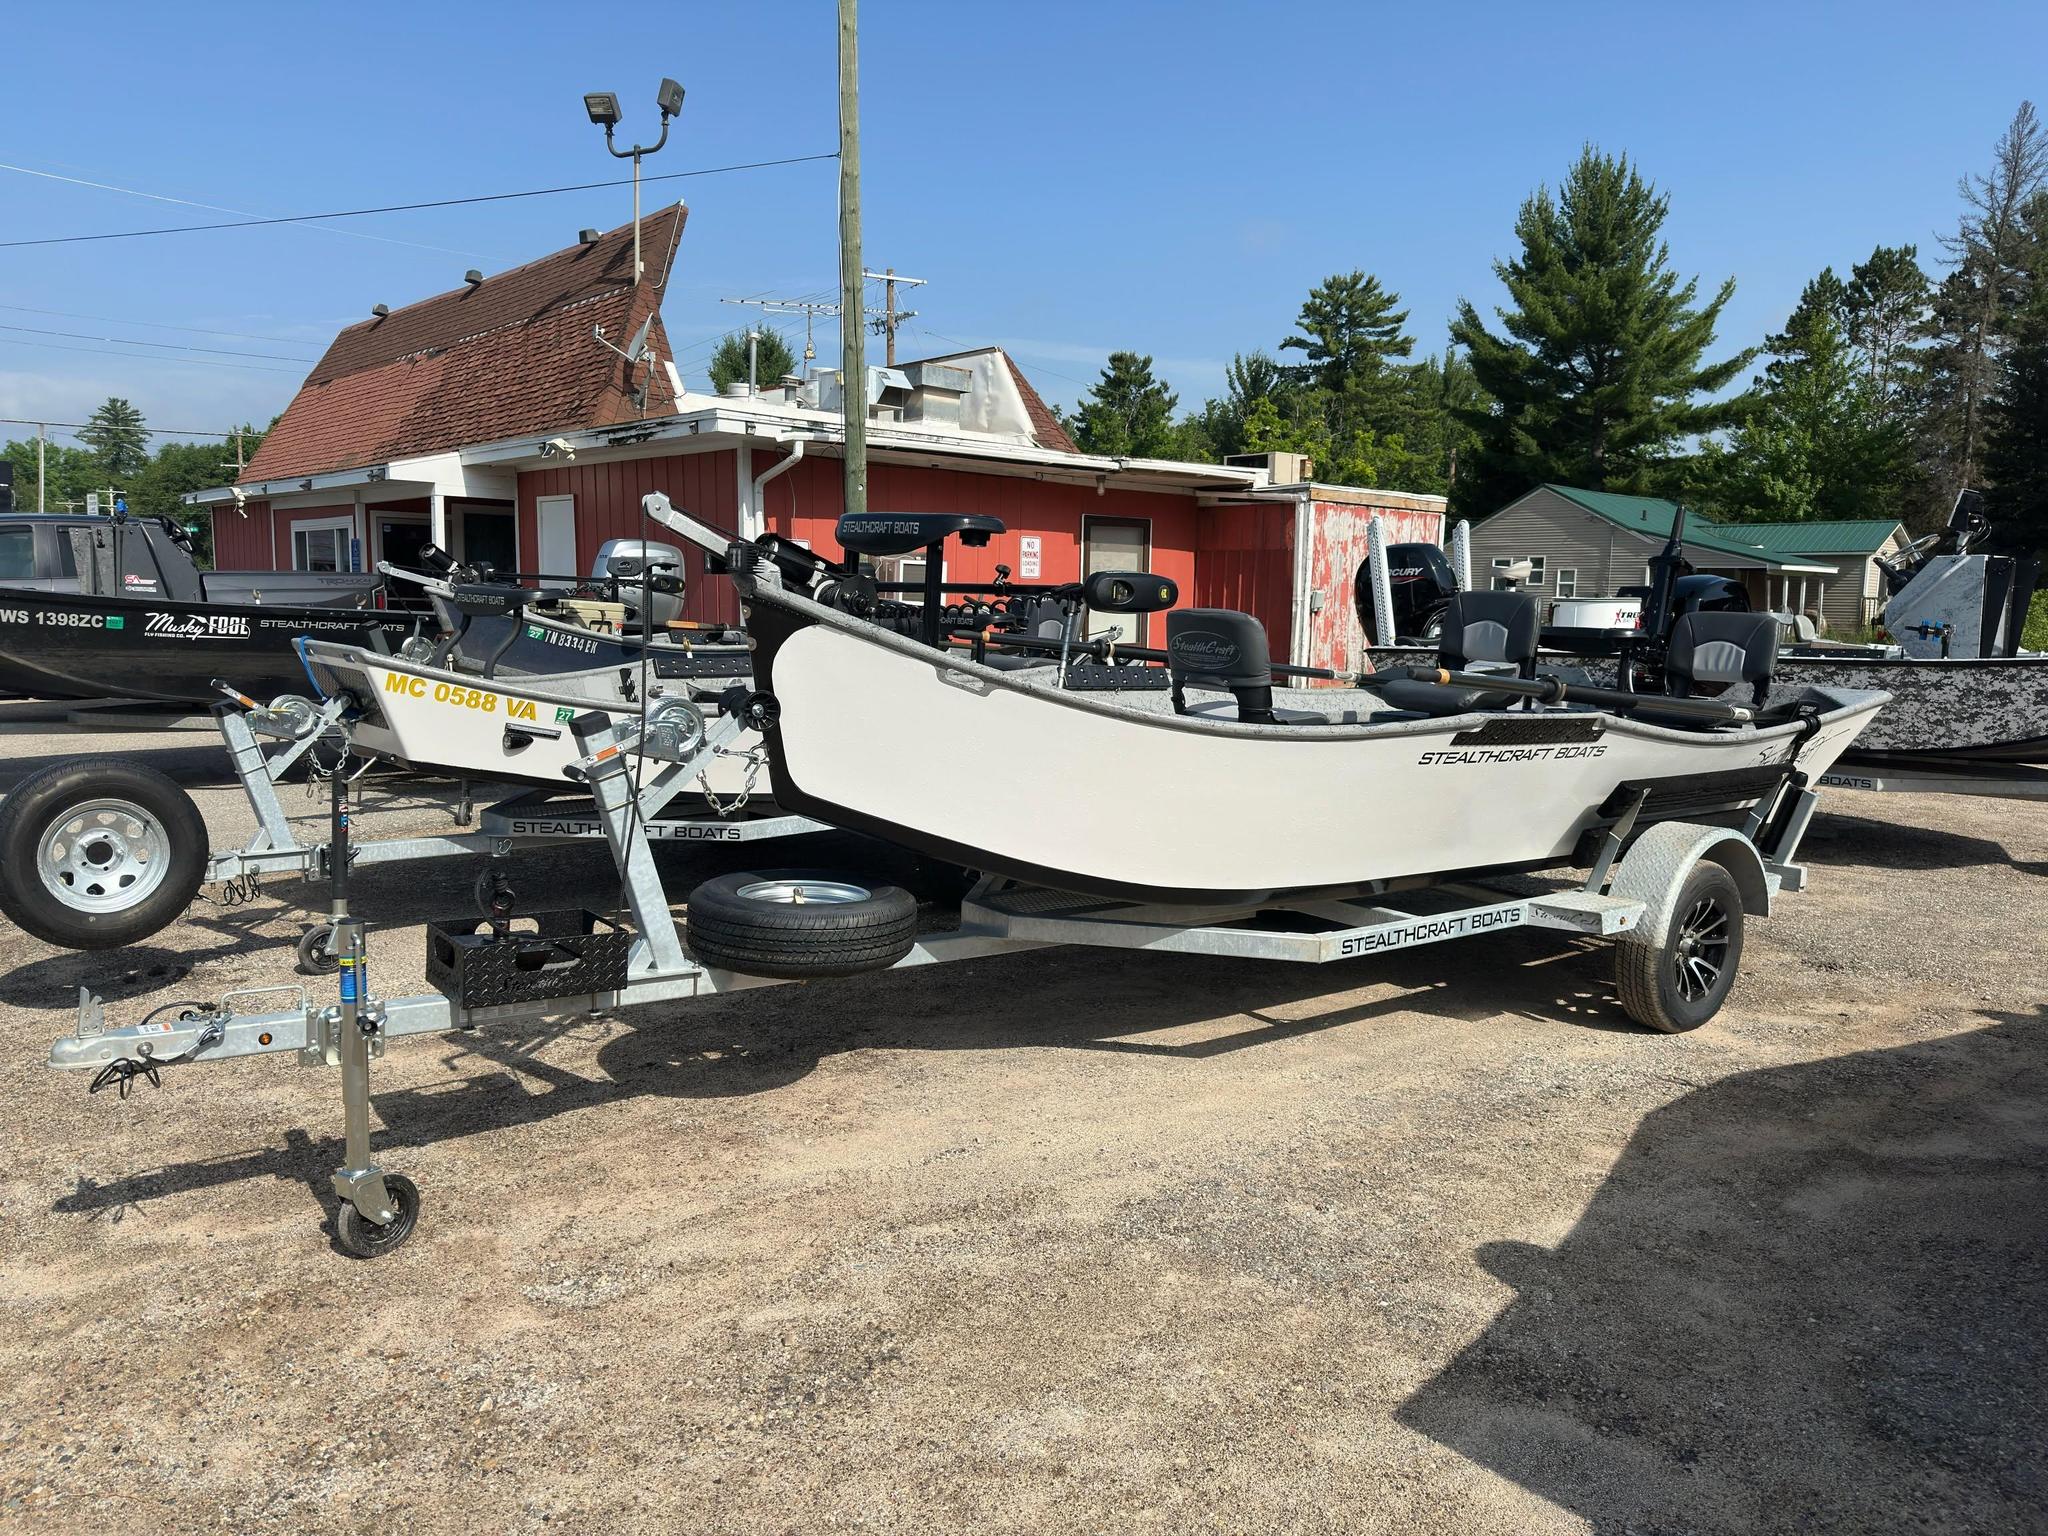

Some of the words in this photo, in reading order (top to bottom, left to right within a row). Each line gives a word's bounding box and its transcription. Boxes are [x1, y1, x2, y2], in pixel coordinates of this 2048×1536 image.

[843, 521, 892, 534] STEALTHCRAFT
[893, 522, 920, 535] BOATS
[1026, 541, 1035, 549] NO
[456, 593, 488, 604] STEALTHCRAFT
[488, 595, 505, 606] BOATS
[0, 609, 30, 624] WS
[35, 611, 104, 628] 1398ZC
[260, 619, 360, 631] STEALTHCRAFT
[379, 623, 405, 632] ATS
[957, 617, 974, 626] BOATS
[144, 612, 206, 641] Musky
[208, 616, 249, 635] FOOL
[529, 630, 541, 639] 27
[544, 629, 559, 645] TN
[558, 633, 585, 651] 8334
[384, 672, 427, 698] MC
[434, 683, 498, 713] 0588
[506, 698, 538, 721] VA
[557, 711, 572, 721] 27
[1418, 748, 1555, 765] STEALTHCRAFT
[1554, 746, 1608, 760] BOATS
[1819, 776, 1872, 789] BOATS
[674, 826, 741, 840] BOATS
[1341, 917, 1467, 955] STEALTHCRAFT
[1471, 908, 1521, 929] BOATS
